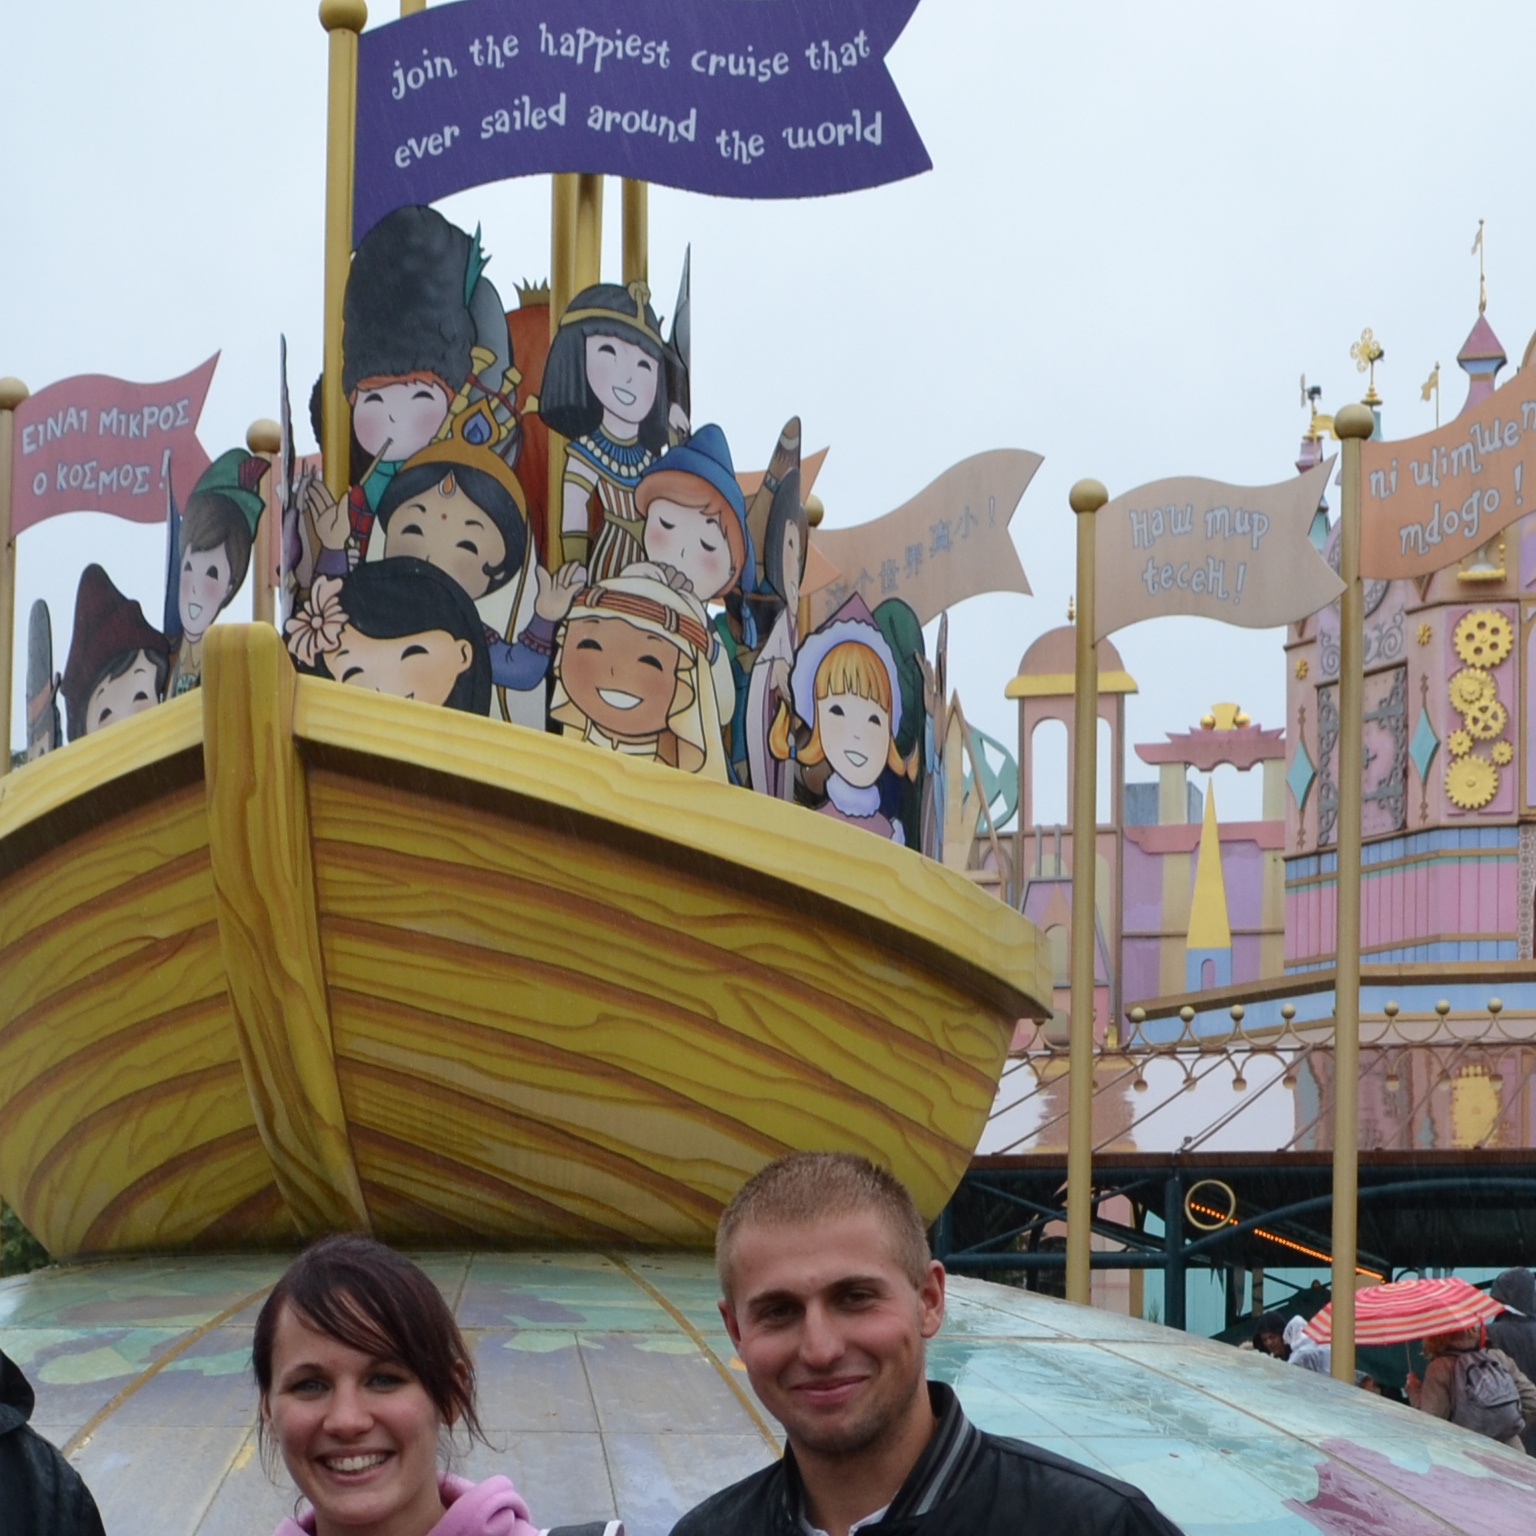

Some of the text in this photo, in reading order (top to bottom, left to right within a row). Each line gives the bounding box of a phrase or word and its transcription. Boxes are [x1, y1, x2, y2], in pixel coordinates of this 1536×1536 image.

[392, 22, 870, 100] join the happiest cruise that
[394, 92, 882, 169] ever sailed around the world
[1369, 457, 1398, 500] ni
